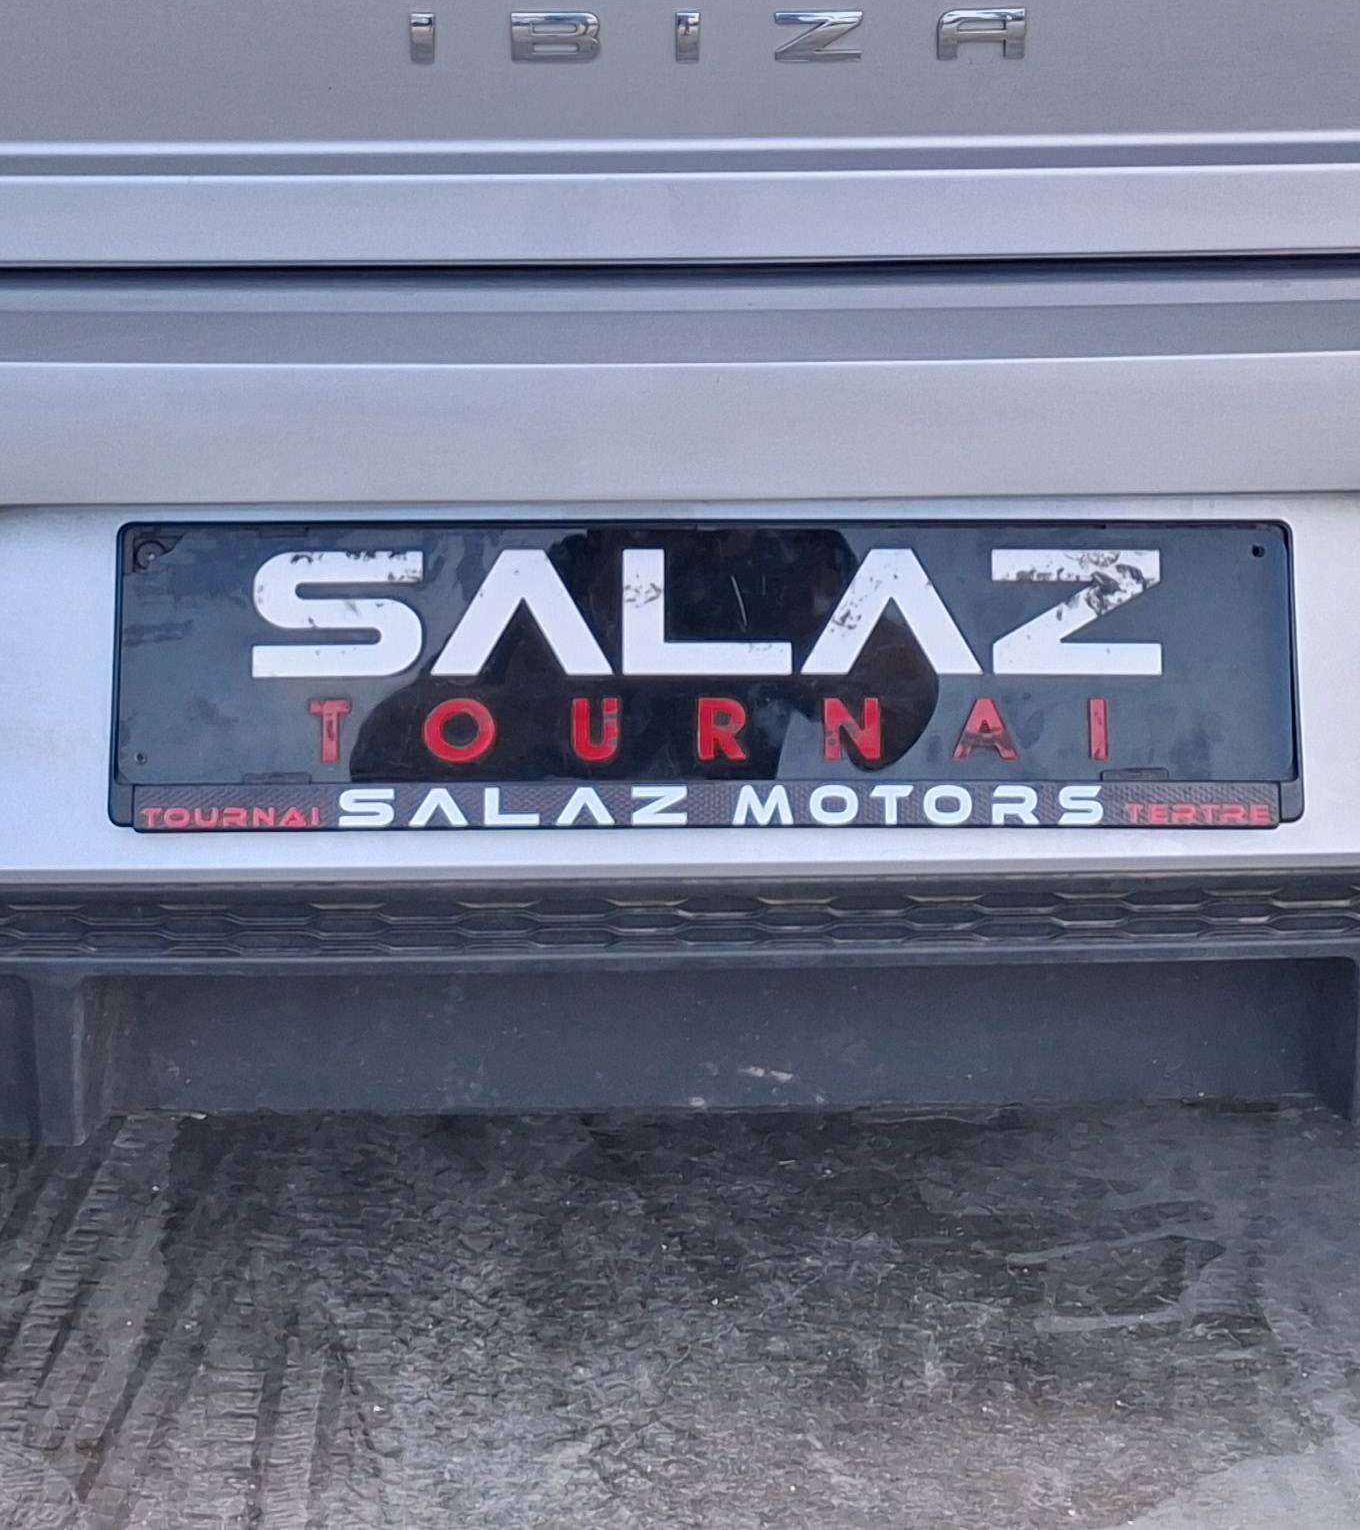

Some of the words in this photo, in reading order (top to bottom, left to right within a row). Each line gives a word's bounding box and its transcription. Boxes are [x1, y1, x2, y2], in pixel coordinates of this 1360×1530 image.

[408, 7, 1027, 63] IBIZA
[252, 548, 1162, 677] SALAZ
[309, 697, 1109, 764] TOURNAI
[141, 806, 320, 828] TOURNAI
[340, 785, 688, 828] SALAZ
[733, 785, 1103, 826] MOTORS
[1124, 803, 1270, 825] TERTRE
